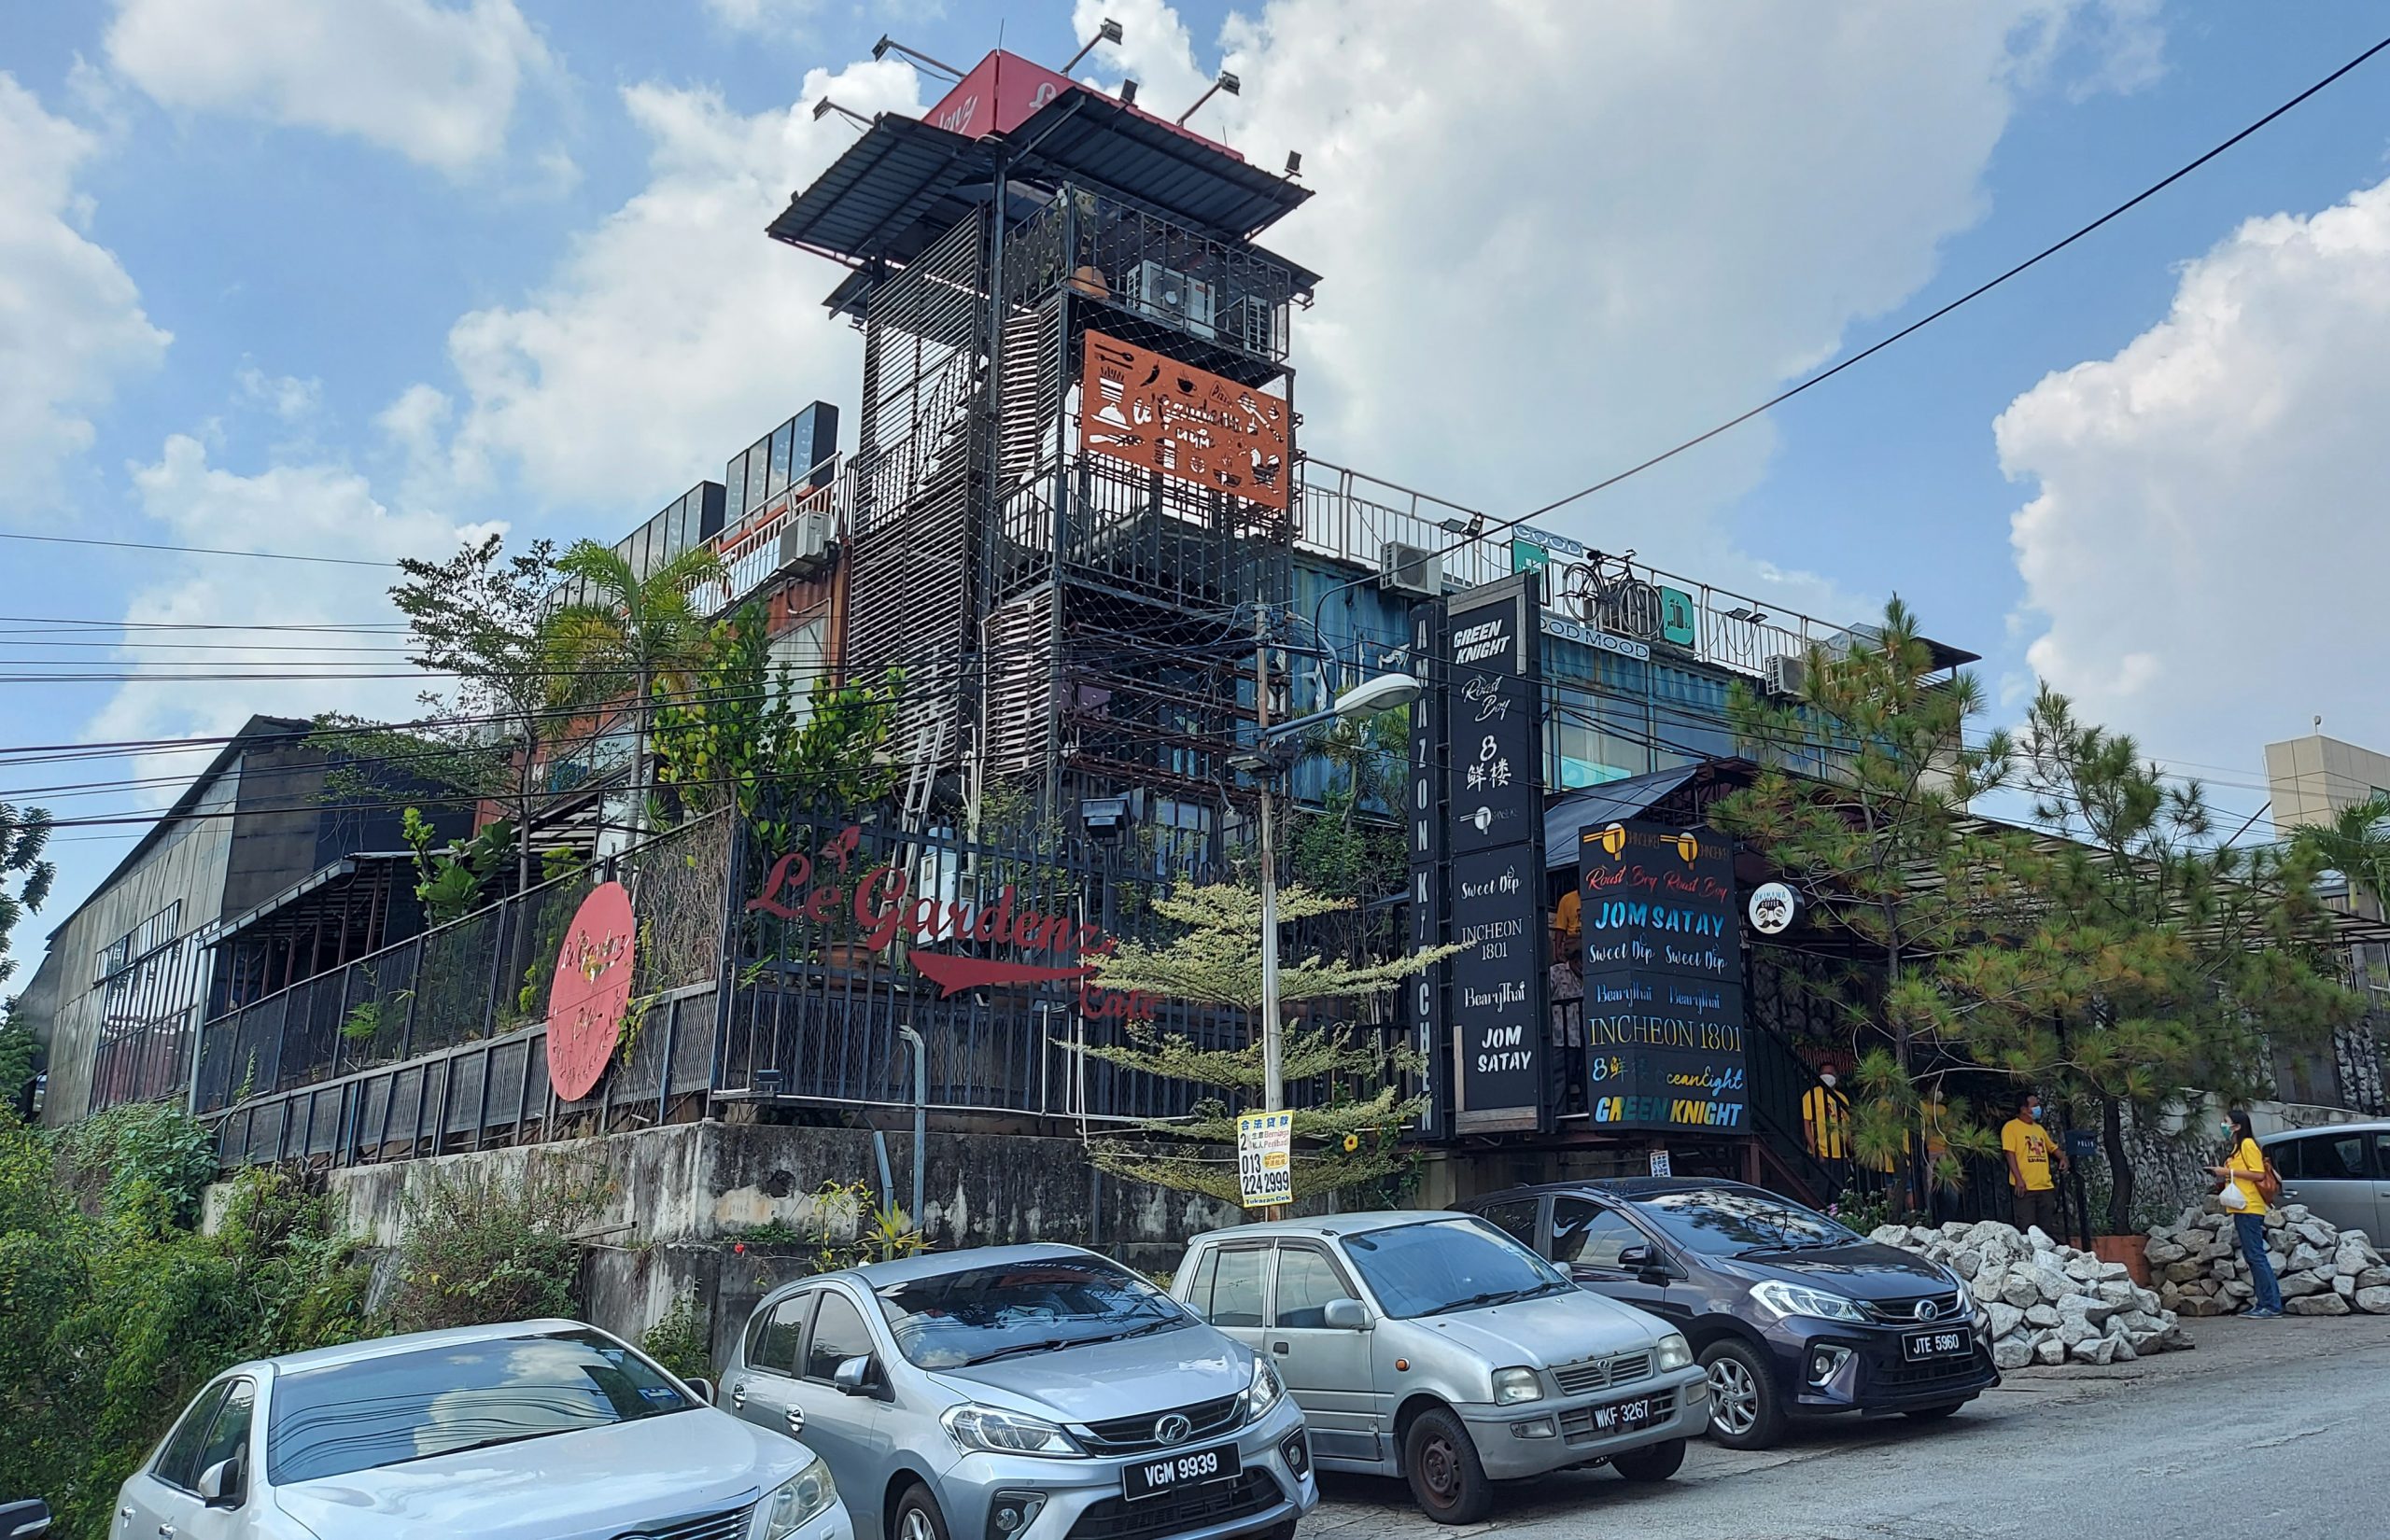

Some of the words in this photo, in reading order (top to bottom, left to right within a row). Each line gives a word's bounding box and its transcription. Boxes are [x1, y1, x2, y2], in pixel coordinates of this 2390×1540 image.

[1513, 525, 1582, 554] GOOD
[1454, 619, 1503, 649] GREEN
[1585, 631, 1649, 659] MOOD
[1455, 636, 1511, 665] KNIGHT
[1461, 674, 1503, 704] Roast
[1474, 694, 1510, 723] Boy
[1415, 619, 1429, 851] AMAZON
[1480, 735, 1497, 762] 8
[1460, 876, 1496, 901] Sweet
[1499, 873, 1523, 896] Dip
[1585, 864, 1627, 891] Roast
[854, 866, 1118, 952] Gardenz
[1754, 890, 1786, 902] OKINAWA
[1461, 918, 1523, 945] INCHEON
[1594, 901, 1647, 931] JOM
[1652, 908, 1725, 939] SATAY
[1481, 941, 1508, 961] 1801
[1589, 944, 1628, 965] Sweet
[1631, 939, 1655, 966] Dip
[1665, 945, 1701, 968] Sweet
[1704, 951, 1728, 975] Dip
[1481, 1025, 1523, 1049] JOM
[1589, 1015, 1694, 1047] INCHEON
[1699, 1022, 1742, 1053] 1801
[1477, 1050, 1532, 1073] SATAY
[1595, 1096, 1668, 1123] GREEN
[1669, 1099, 1744, 1127] KNIGHT
[1242, 1154, 1261, 1175] 013
[1243, 1174, 1263, 1196] 224
[1264, 1170, 1289, 1194] 2999
[1913, 1337, 1933, 1354] JTE
[1595, 1407, 1619, 1429] WKF
[1621, 1399, 1649, 1422] 3267
[1145, 1461, 1175, 1488] VGM
[1177, 1452, 1217, 1479] 9939
